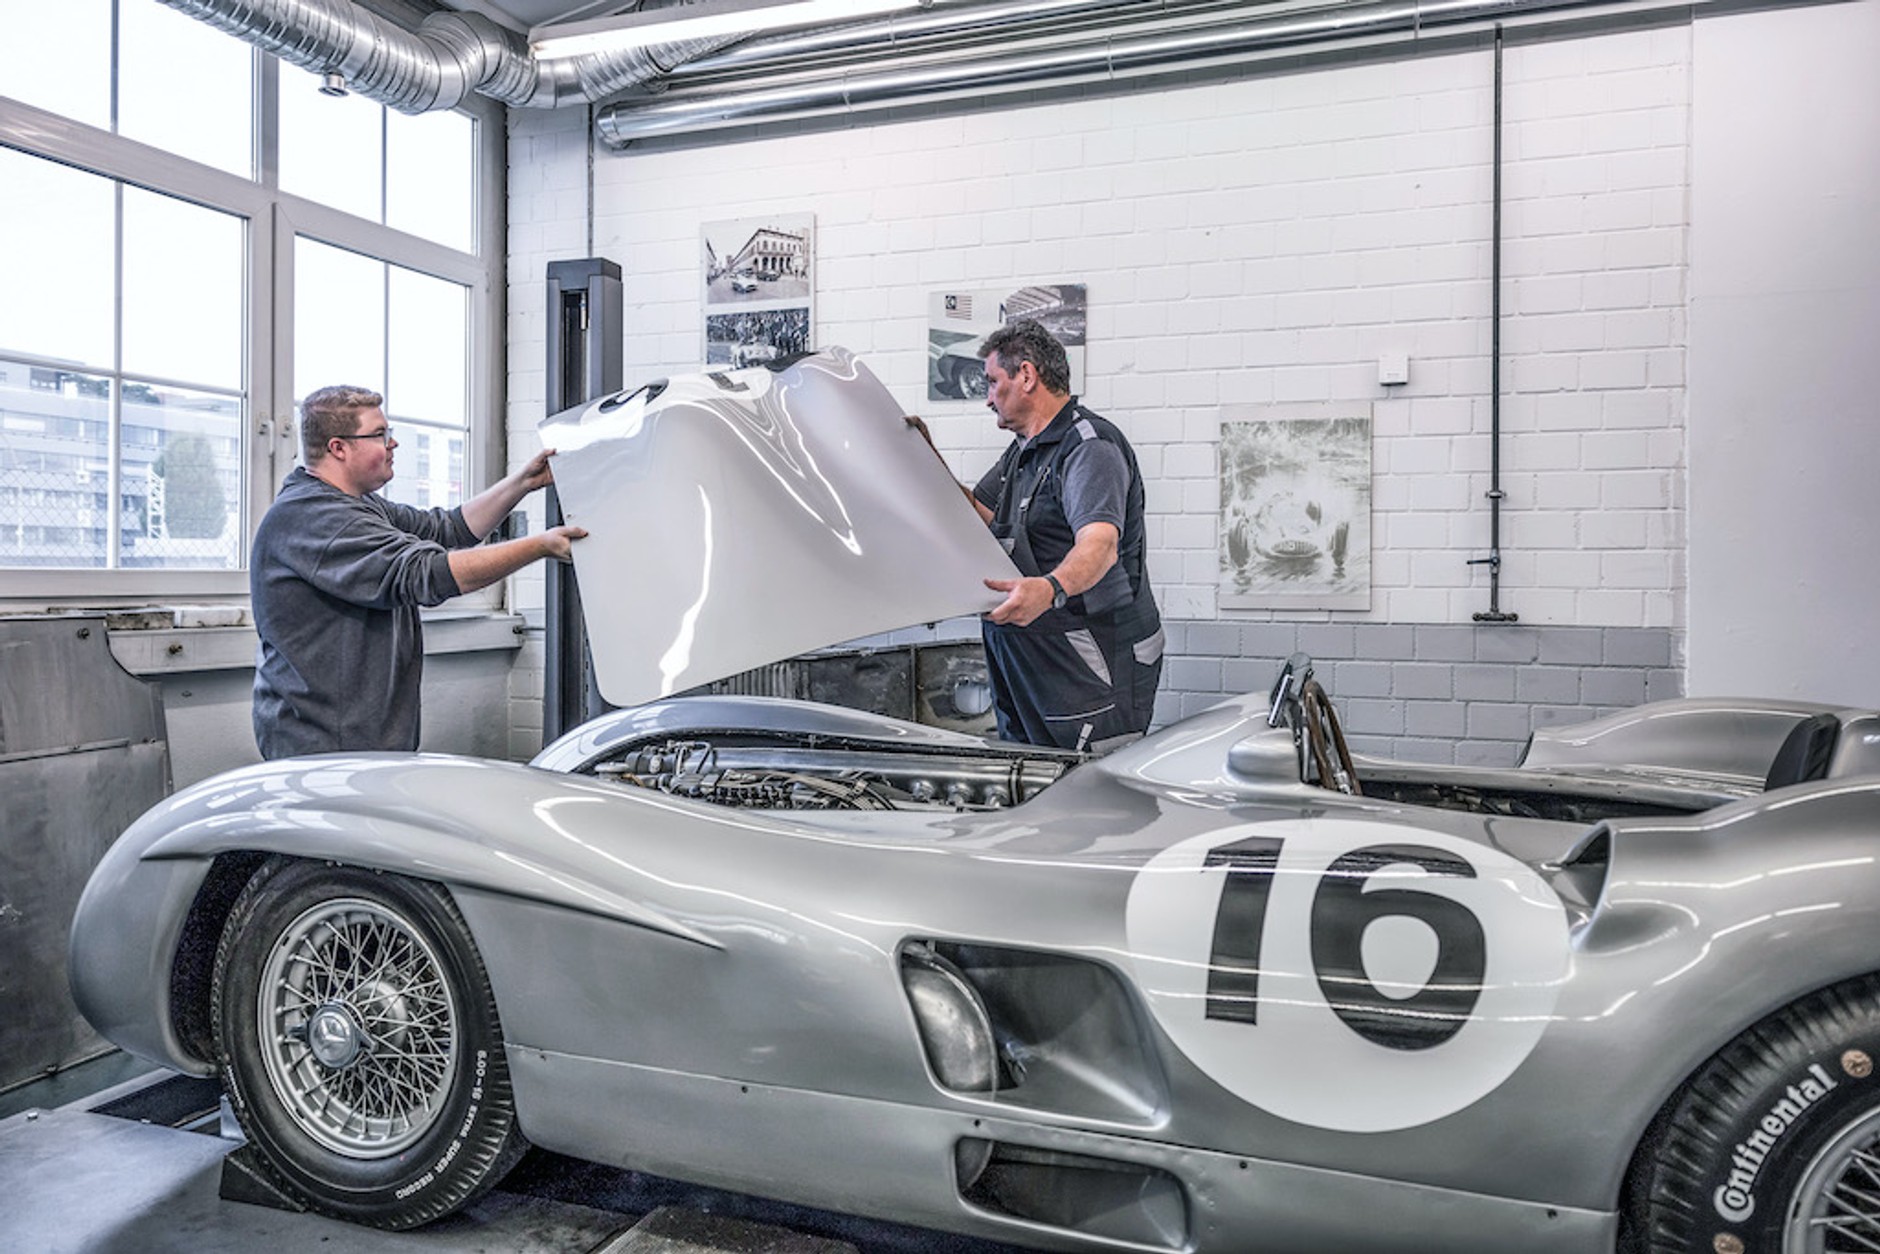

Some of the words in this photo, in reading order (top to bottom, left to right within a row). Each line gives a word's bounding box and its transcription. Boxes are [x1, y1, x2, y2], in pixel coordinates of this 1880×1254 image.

[1201, 836, 1487, 1051] 16
[396, 1173, 433, 1198] RECORD
[435, 1140, 460, 1173] SUPER
[1713, 1063, 1838, 1223] Continental
